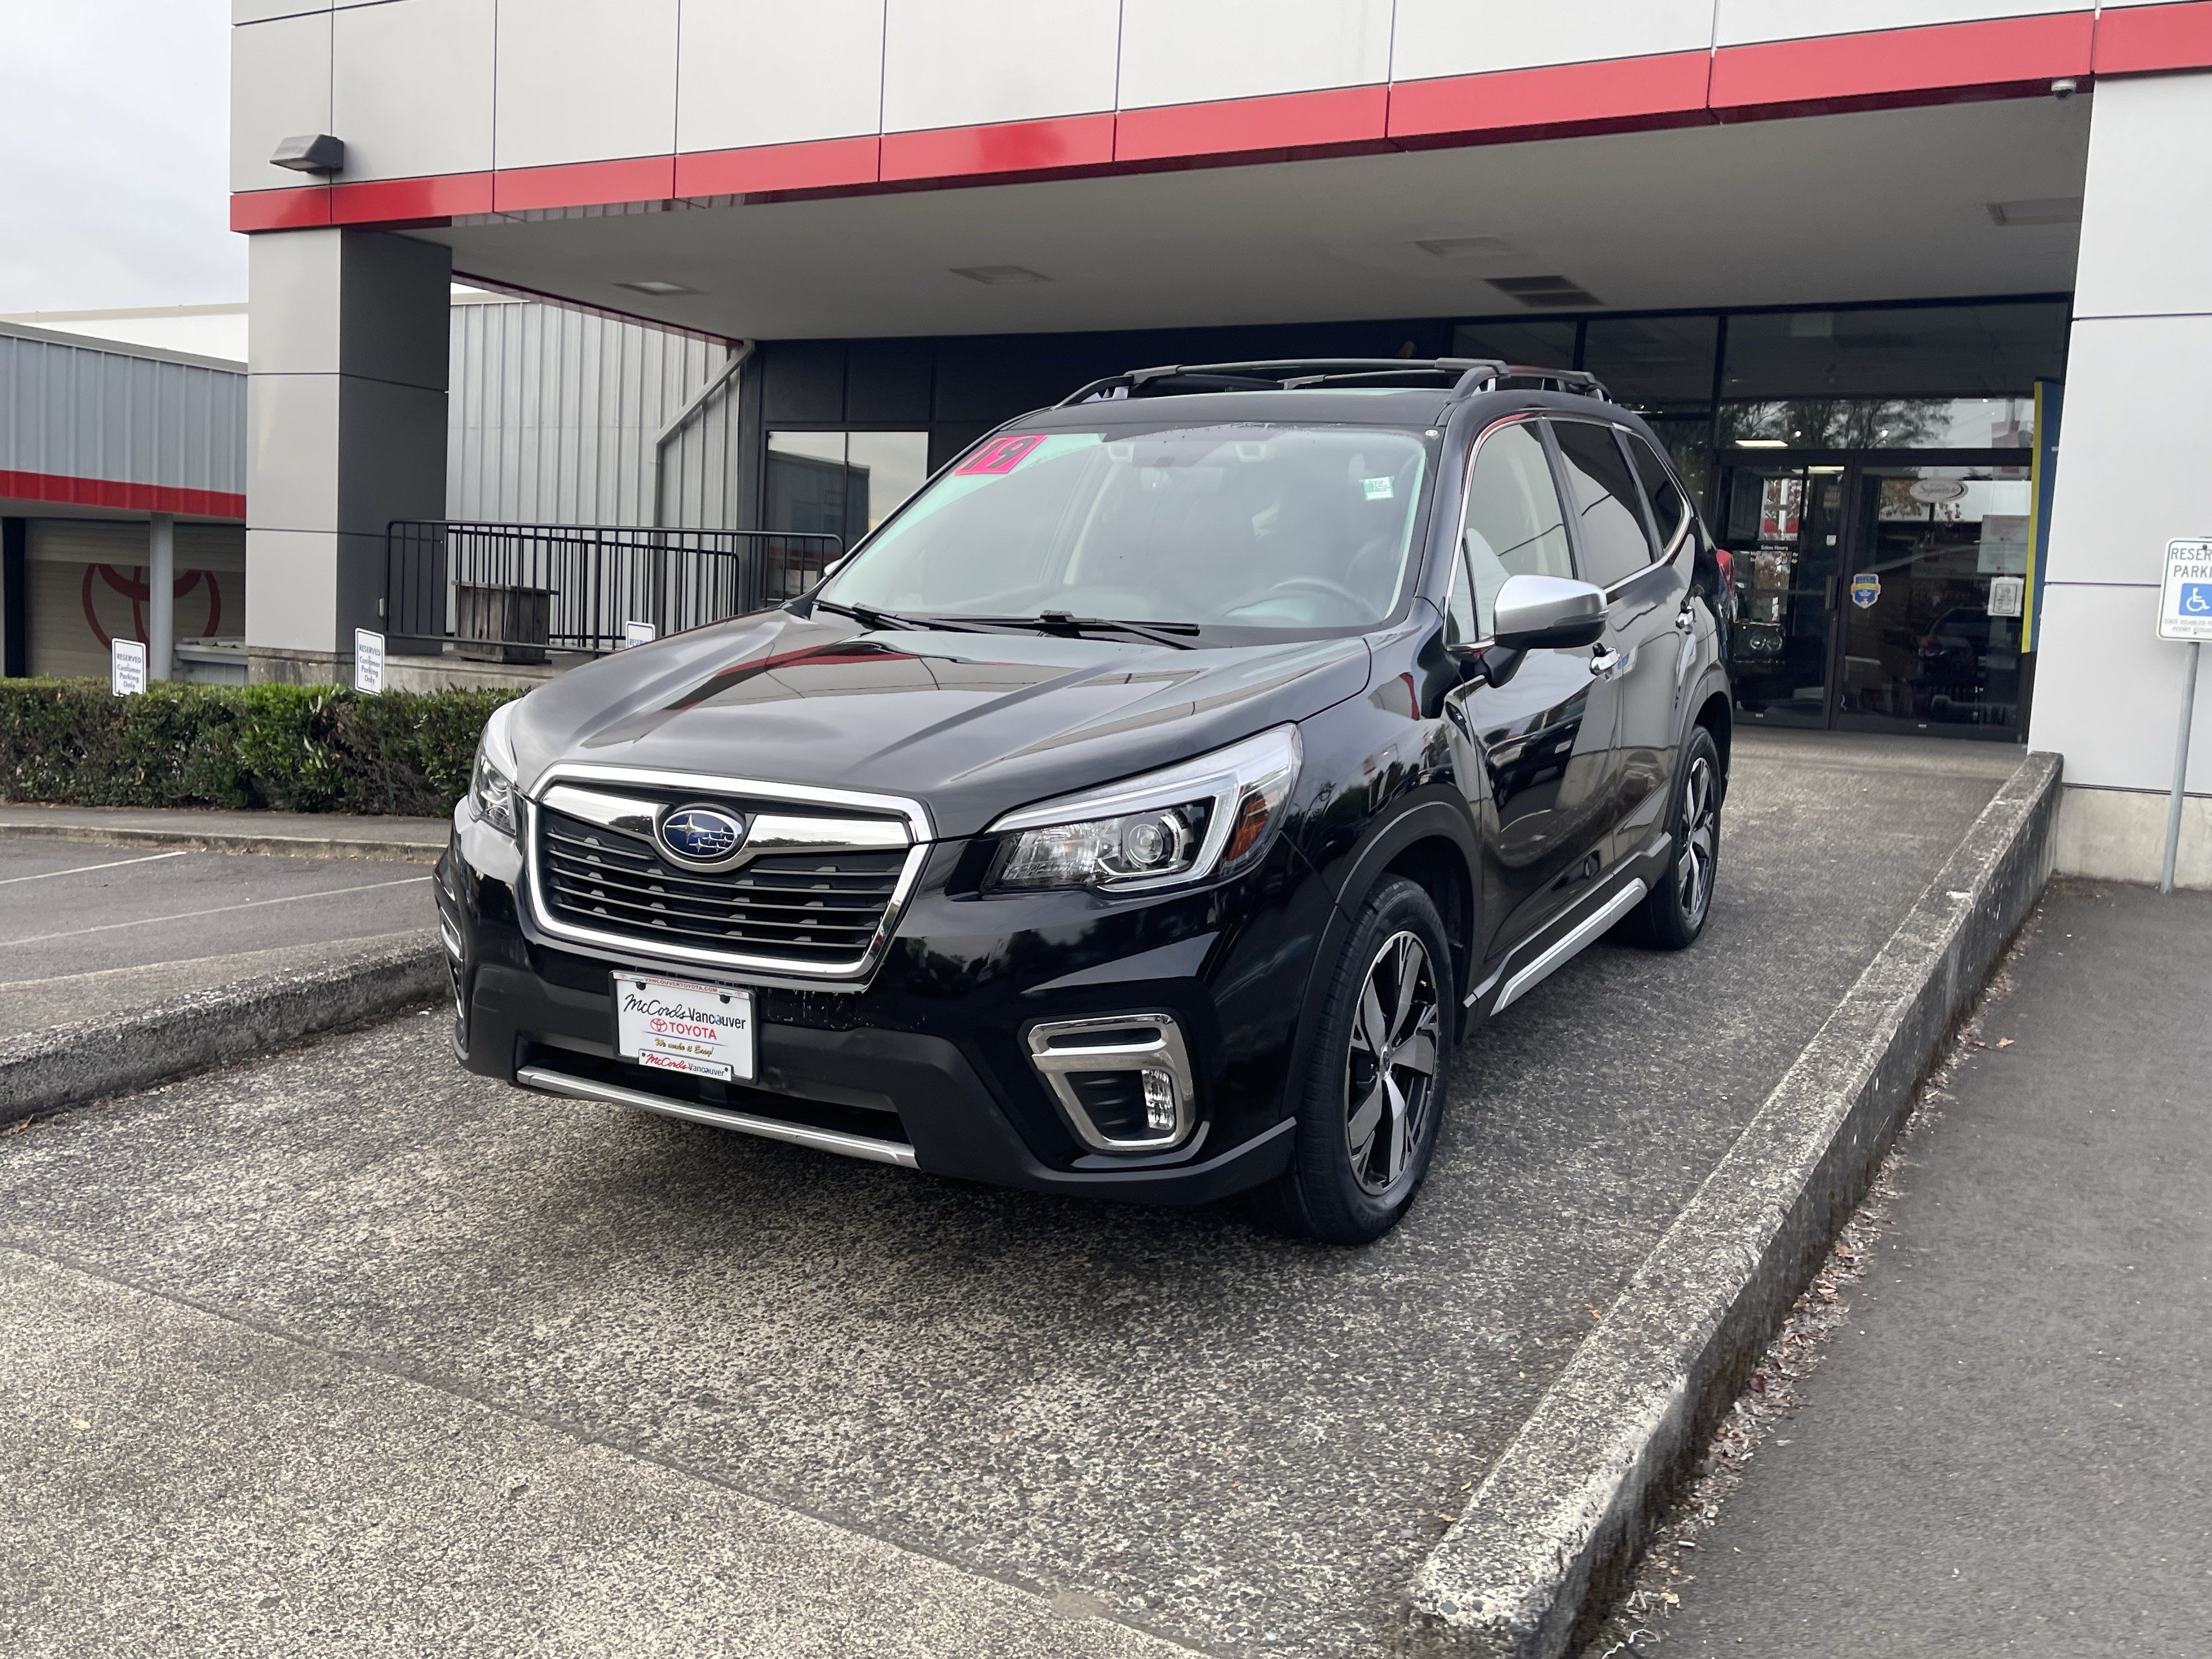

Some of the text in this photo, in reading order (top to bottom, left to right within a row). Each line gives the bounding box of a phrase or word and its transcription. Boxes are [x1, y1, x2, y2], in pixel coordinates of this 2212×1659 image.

[961, 437, 1036, 470] 19
[359, 644, 381, 657] RESERVED
[117, 653, 142, 663] RESERVED
[359, 656, 381, 668] Customer
[117, 663, 142, 674] Customer
[362, 665, 378, 678] Parking
[120, 672, 139, 684] Parking
[364, 675, 375, 685] Only
[123, 681, 135, 690] Only
[645, 977, 718, 992] VANCOUVERTOYOTA.COM
[669, 1022, 717, 1040] TOYOTA
